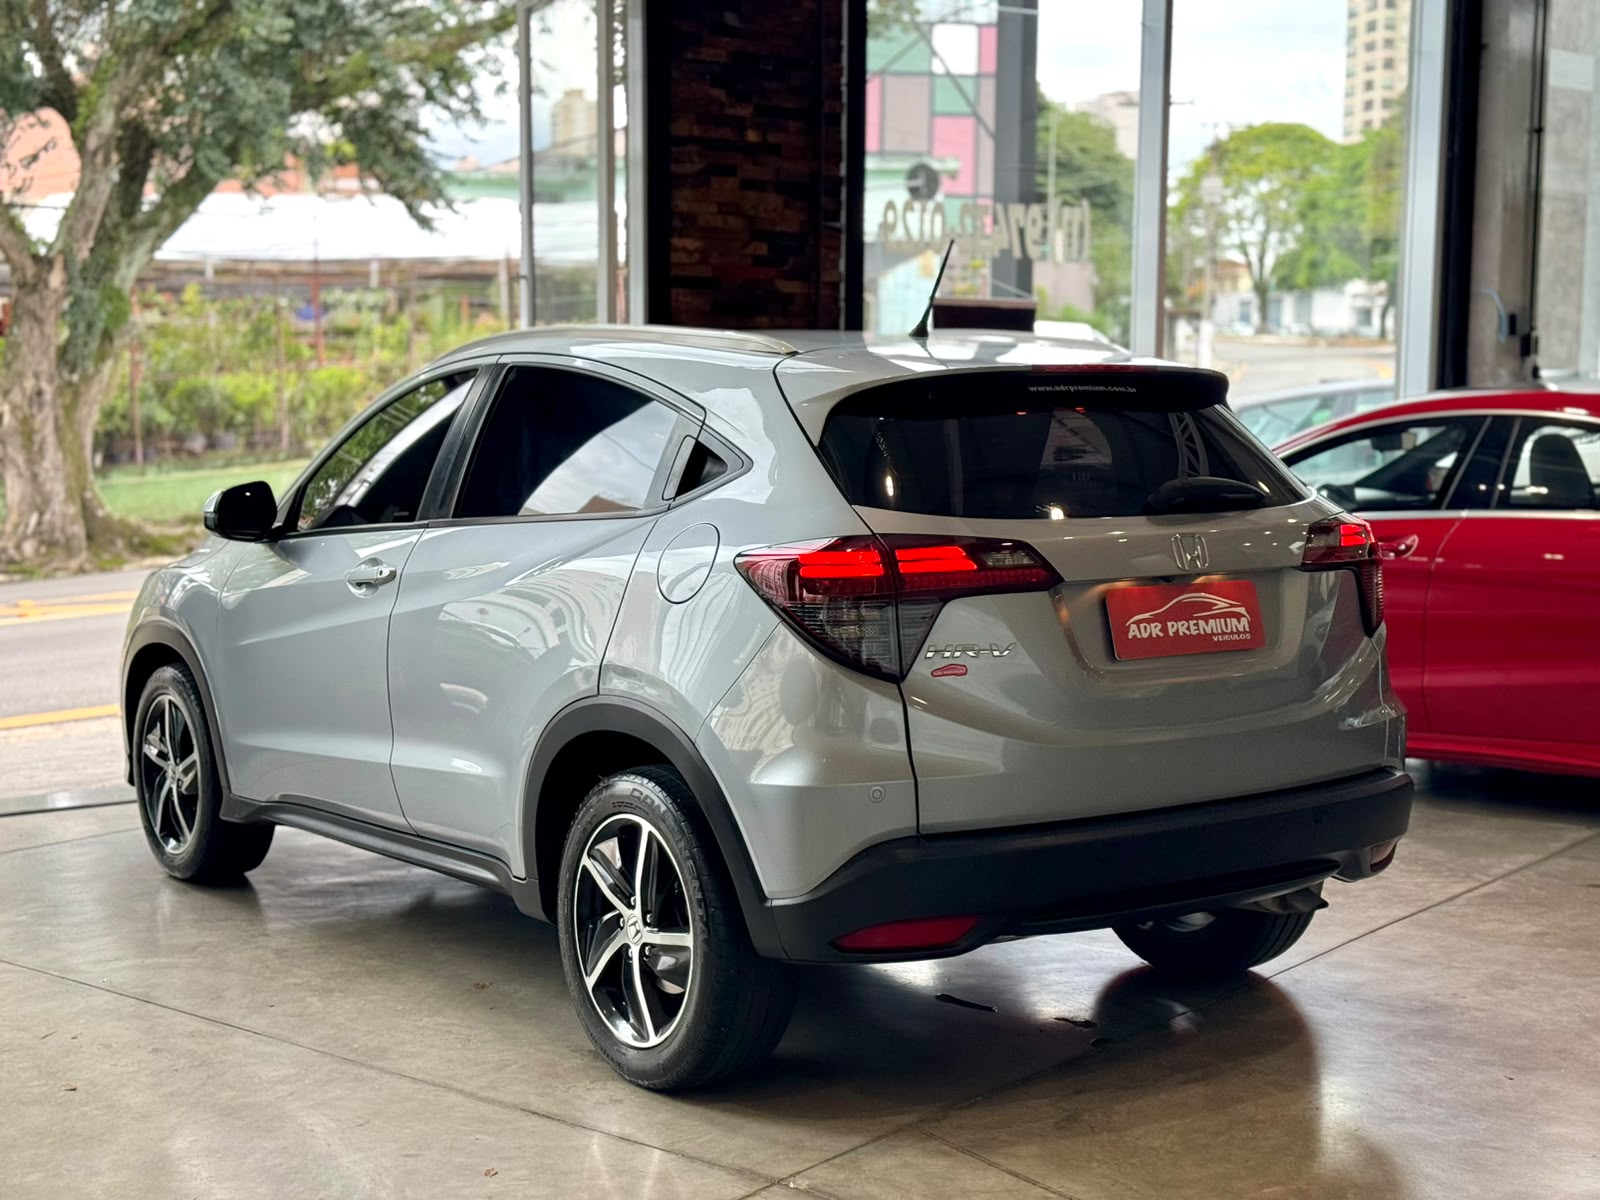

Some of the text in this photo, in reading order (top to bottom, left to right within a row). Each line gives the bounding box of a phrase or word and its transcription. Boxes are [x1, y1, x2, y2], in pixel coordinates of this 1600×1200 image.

[1127, 617, 1250, 640] ADR PREMIUM
[924, 642, 1017, 660] HR-V
